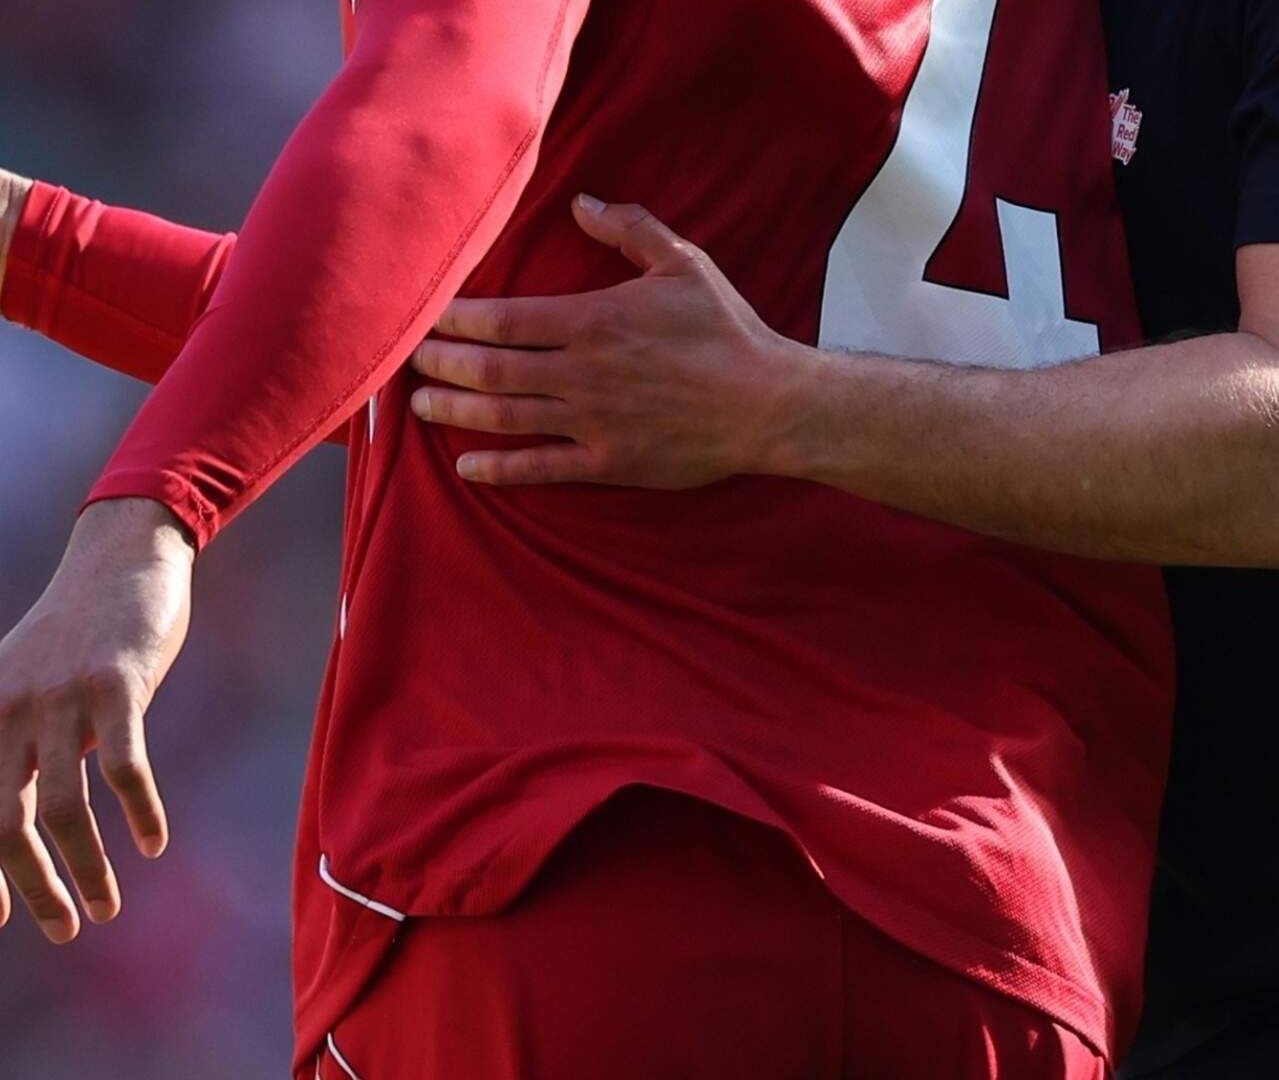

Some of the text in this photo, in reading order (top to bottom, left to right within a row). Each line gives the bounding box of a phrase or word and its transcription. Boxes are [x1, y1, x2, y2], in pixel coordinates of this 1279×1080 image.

[1122, 105, 1141, 125] The
[1116, 123, 1137, 142] Red
[1112, 141, 1134, 163] Way
